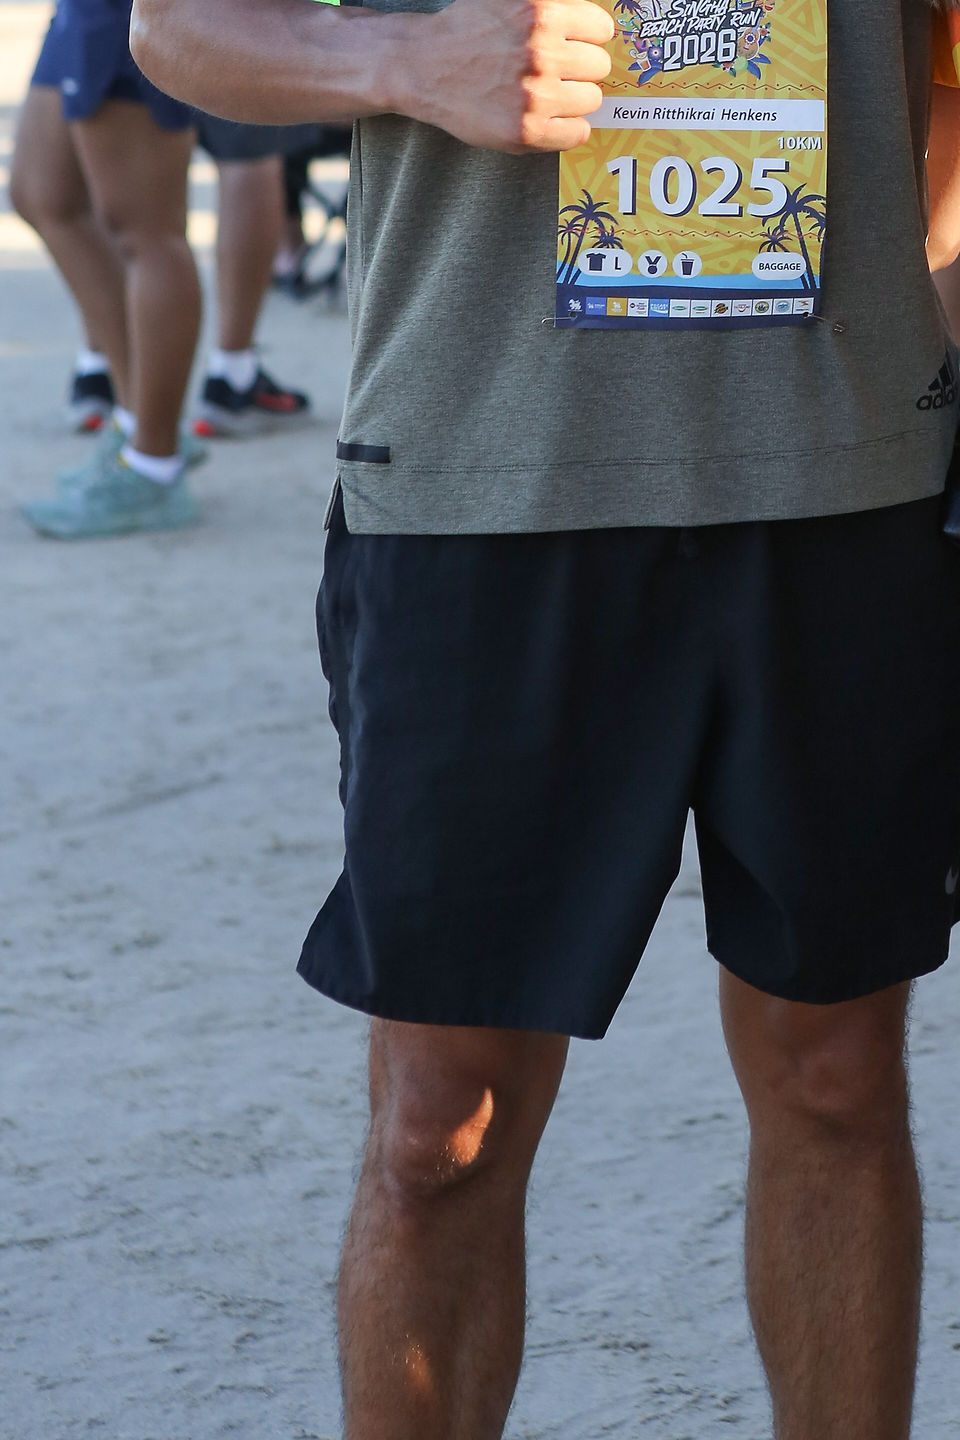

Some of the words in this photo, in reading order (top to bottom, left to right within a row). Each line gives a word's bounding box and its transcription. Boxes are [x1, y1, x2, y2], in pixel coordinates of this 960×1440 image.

[640, 18, 685, 38] BEACH
[687, 15, 726, 33] PARTY
[730, 8, 761, 27] RUN
[663, 28, 738, 72] 2026
[613, 106, 649, 120] Kevin
[653, 106, 716, 121] Ritthikrai
[720, 108, 778, 122] Henkens
[777, 136, 823, 150] 10KM
[606, 155, 790, 218] 1025
[614, 256, 622, 271] L
[758, 262, 801, 271] BAGGAGE
